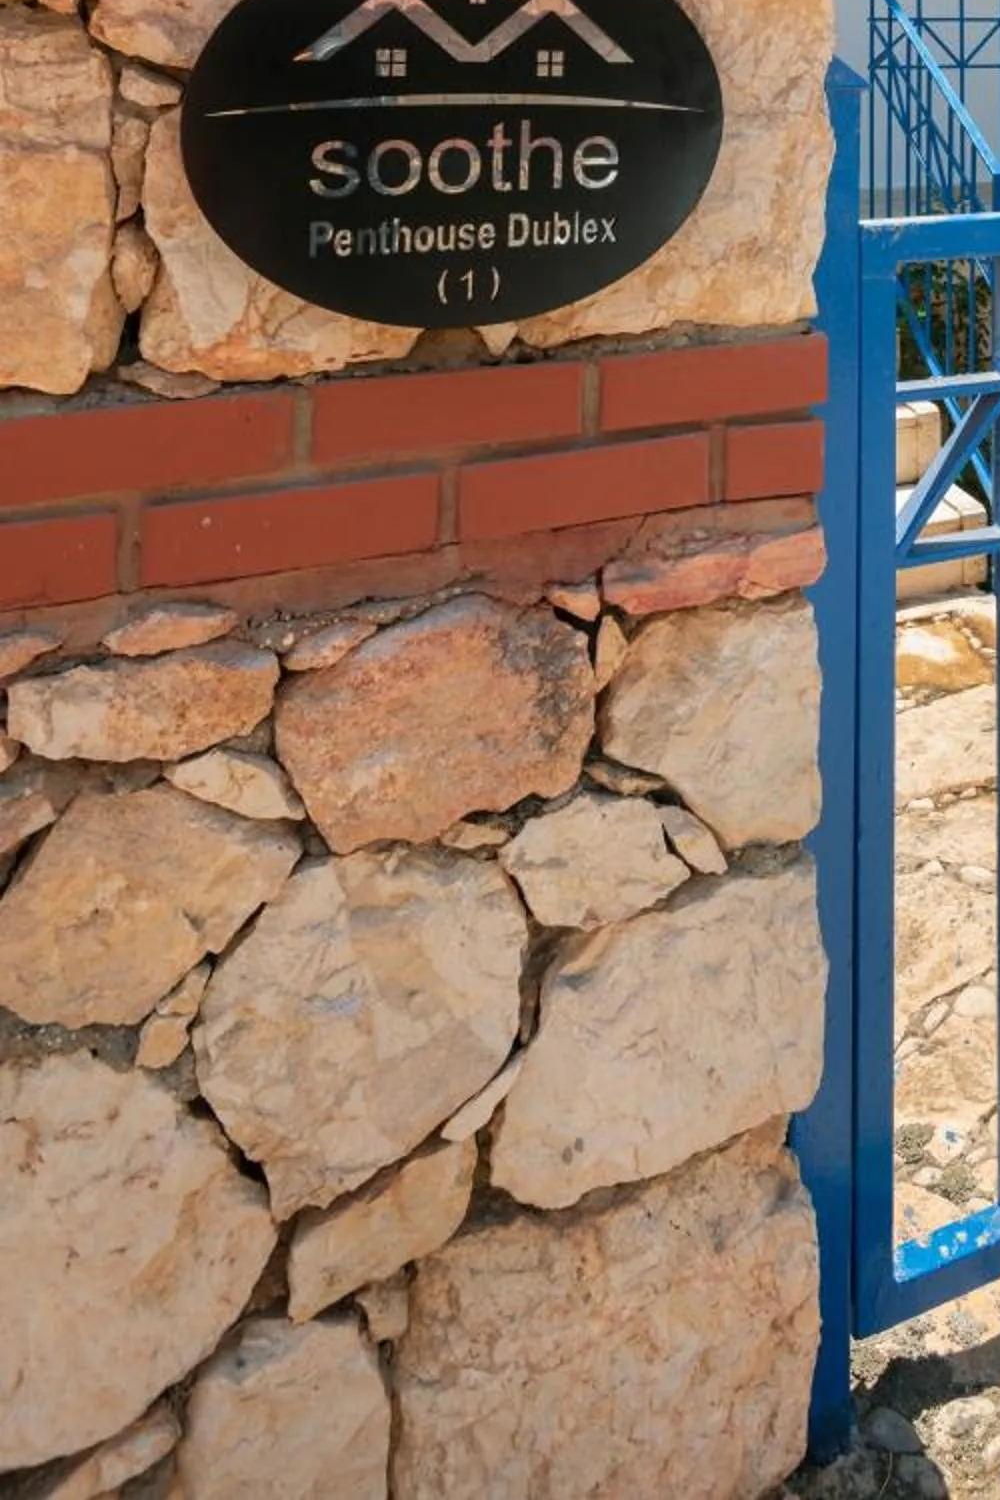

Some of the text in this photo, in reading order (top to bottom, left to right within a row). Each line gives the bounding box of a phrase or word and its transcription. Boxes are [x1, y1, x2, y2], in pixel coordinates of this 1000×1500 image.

[308, 119, 620, 198] soothe
[309, 211, 617, 257] Penthouse Dublex
